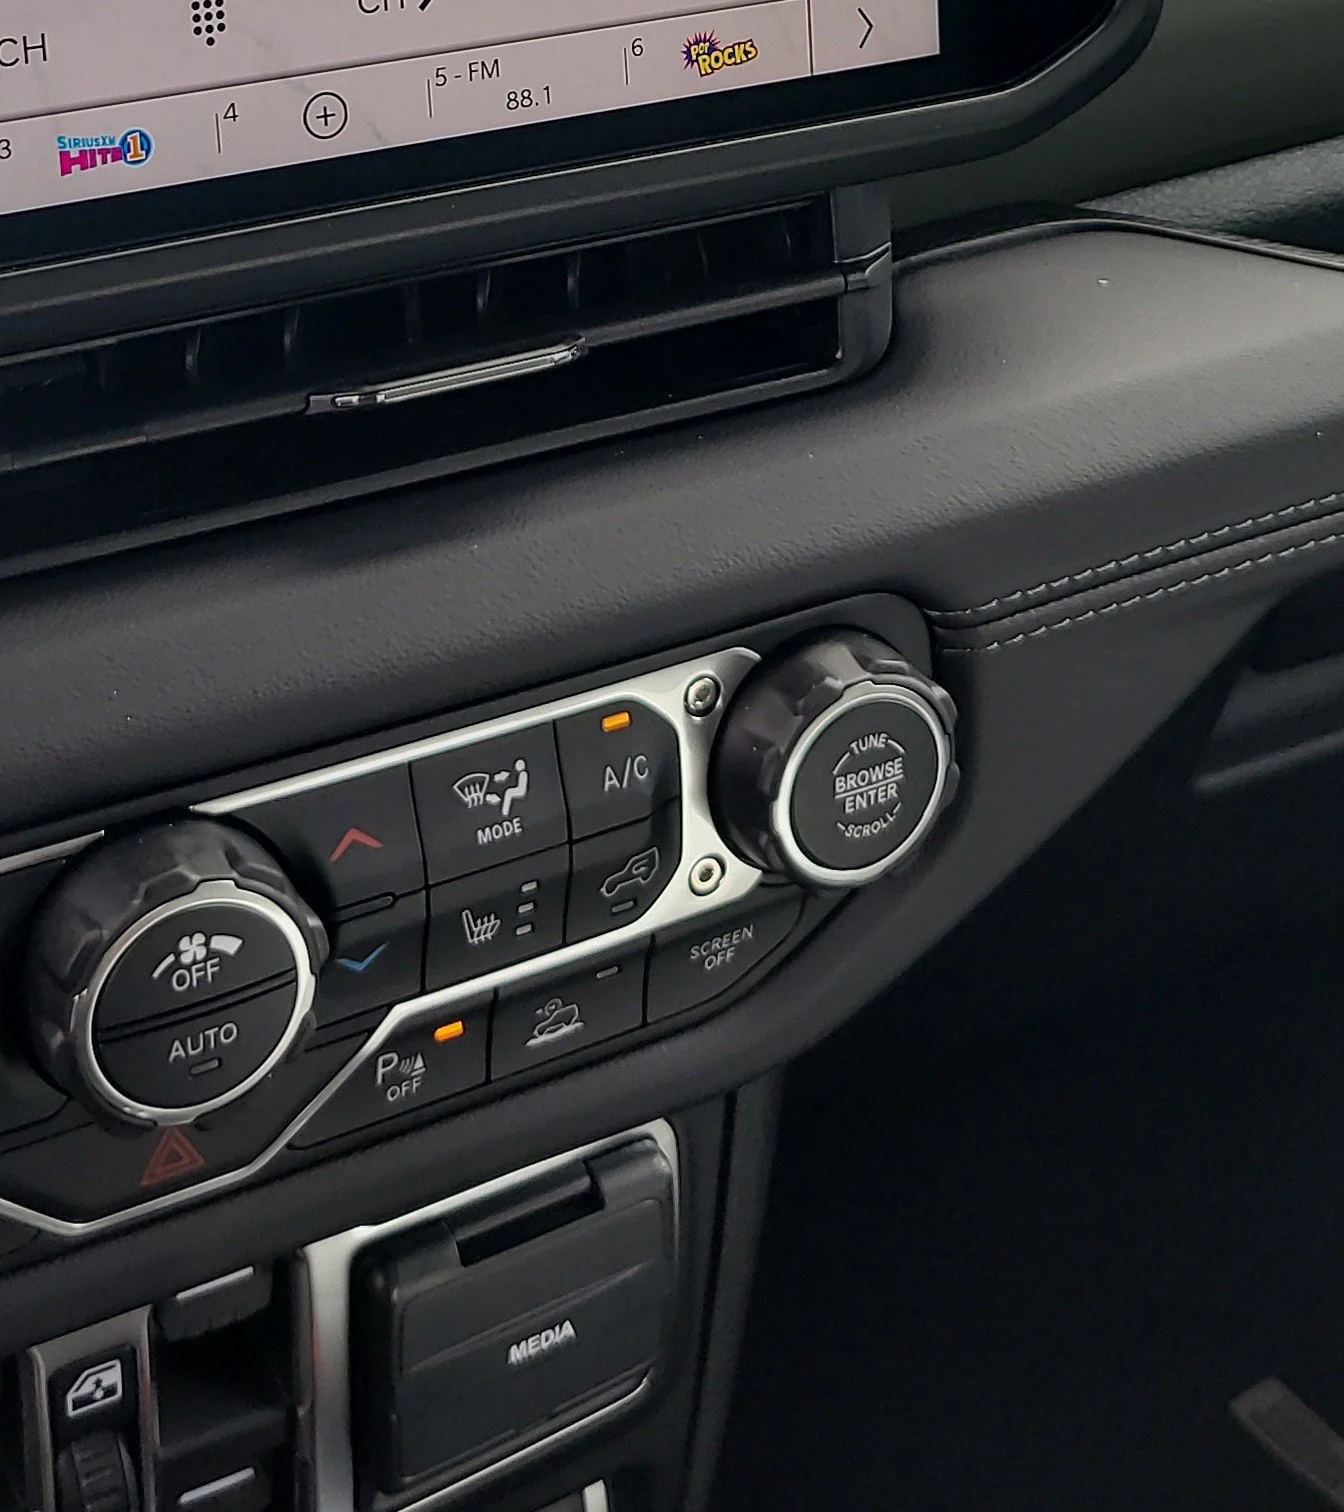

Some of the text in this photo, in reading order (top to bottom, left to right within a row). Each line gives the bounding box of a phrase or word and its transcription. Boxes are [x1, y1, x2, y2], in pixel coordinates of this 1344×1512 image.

[630, 37, 644, 58] 6
[697, 39, 758, 77] ROCKS
[434, 66, 449, 88] 5
[467, 58, 502, 83] FM
[222, 101, 239, 122] 4
[506, 85, 553, 111] 88.1
[849, 731, 889, 758] TUNE
[603, 754, 650, 792] A/C
[834, 756, 905, 794] BROWSE
[844, 782, 900, 815] ENTER
[476, 816, 525, 846] MODE
[843, 811, 898, 841] SCROLL
[689, 924, 755, 963] SCREEN
[704, 945, 736, 971] OFF
[172, 956, 224, 992] OFF
[168, 1021, 239, 1063] AUTO
[386, 1077, 423, 1103] OFF
[508, 1318, 577, 1365] MEDIA
